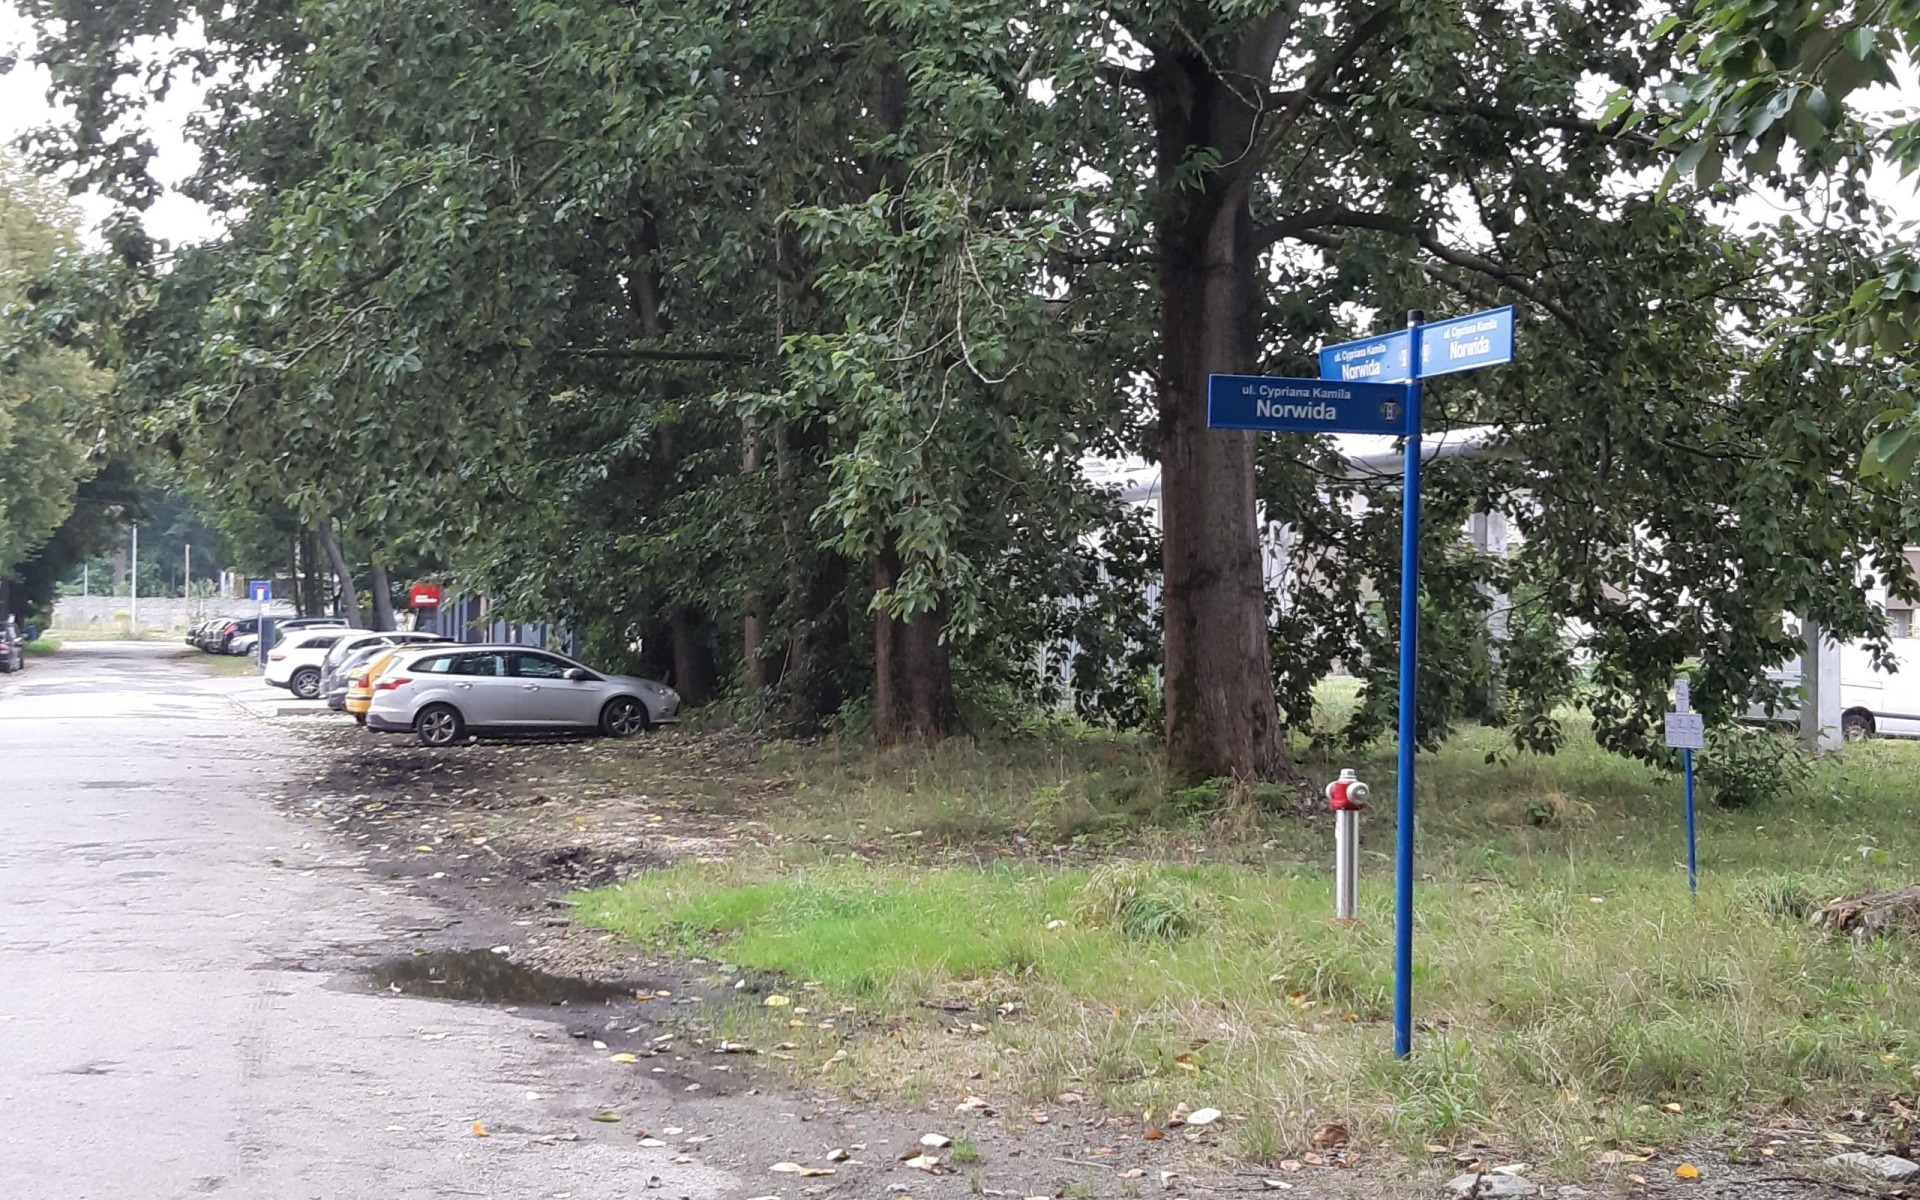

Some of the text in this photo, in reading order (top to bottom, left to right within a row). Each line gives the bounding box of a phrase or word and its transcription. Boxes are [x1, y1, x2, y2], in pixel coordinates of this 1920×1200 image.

[1476, 319, 1498, 332] Kamila
[1367, 343, 1386, 356] Kamila
[1449, 336, 1490, 360] Norwida
[1341, 359, 1381, 380] Norwida
[1242, 385, 1352, 400] ul. Cypriana Kamila
[1256, 399, 1337, 420] Norwida
